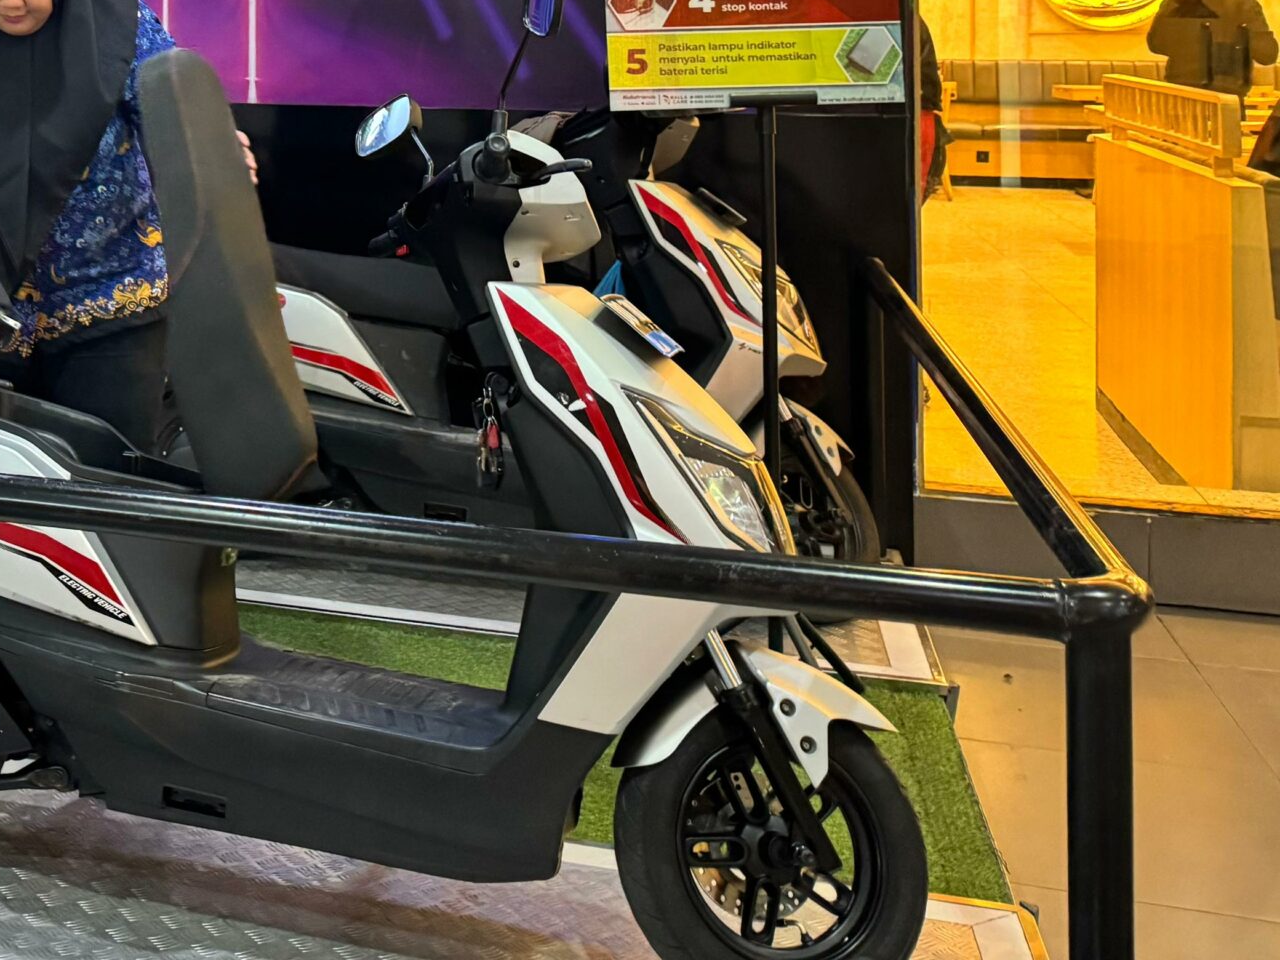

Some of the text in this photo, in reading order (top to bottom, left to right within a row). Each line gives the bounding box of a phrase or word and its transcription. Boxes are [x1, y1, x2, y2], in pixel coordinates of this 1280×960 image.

[721, 1, 788, 13] stop kontak
[658, 40, 797, 52] Pastikan lampu indikator
[626, 48, 648, 75] 5
[659, 52, 817, 65] menyala untuk memastikan
[659, 65, 728, 76] baterai terisi
[58, 574, 128, 619] ELECTRIC VEHICLE
